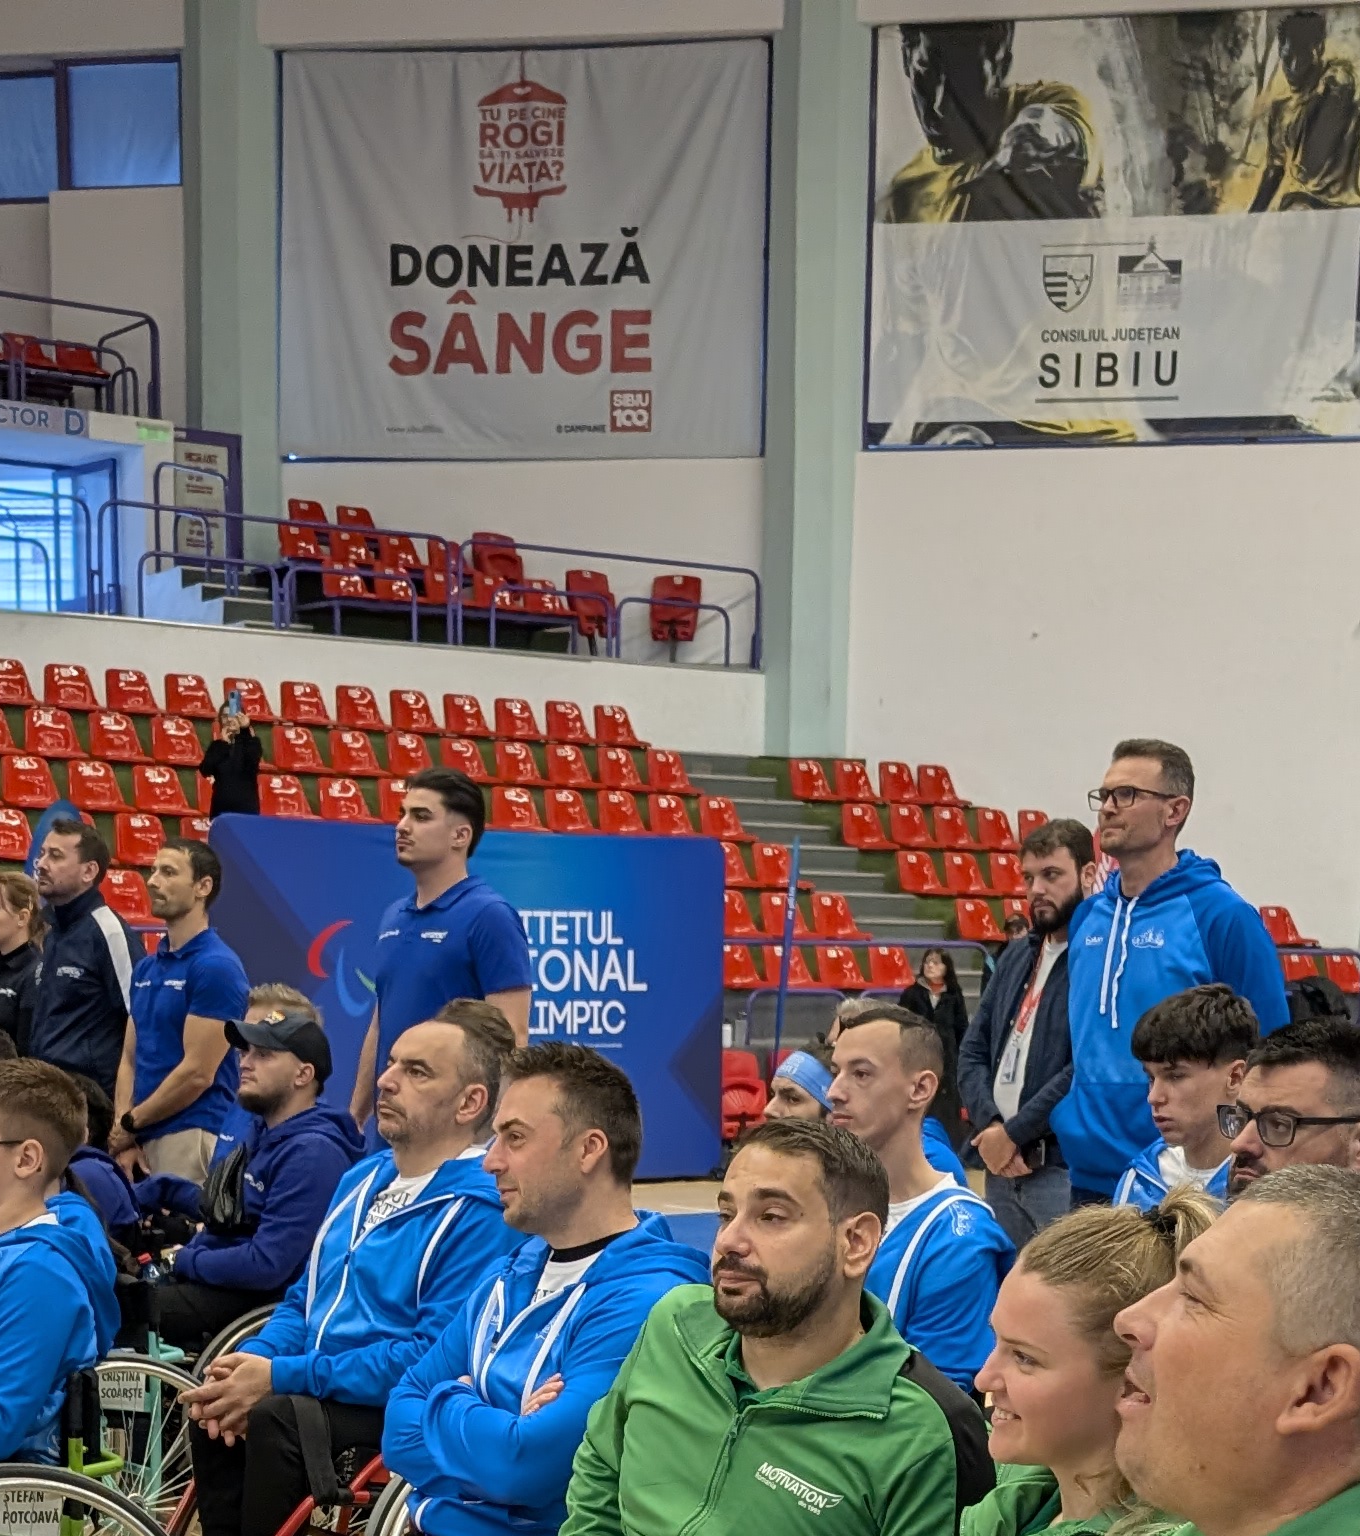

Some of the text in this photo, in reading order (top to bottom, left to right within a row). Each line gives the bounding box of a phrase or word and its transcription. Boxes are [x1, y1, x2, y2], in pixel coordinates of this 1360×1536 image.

[481, 106, 565, 121] TU PE CINE
[480, 121, 565, 149] ROGI
[391, 227, 651, 288] DONEAZĂ
[388, 289, 652, 376] SÂNGE
[1041, 328, 1108, 343] CONSILIUL
[1038, 350, 1178, 388] SIBIU
[612, 393, 649, 408] SIBIU
[64, 409, 85, 436] D
[613, 409, 649, 429] 100
[101, 1371, 141, 1382] CRISTINA
[755, 1471, 777, 1490] Romania
[757, 1461, 828, 1509] MOTIVATION
[2, 1507, 60, 1525] POTCOAVĂ
